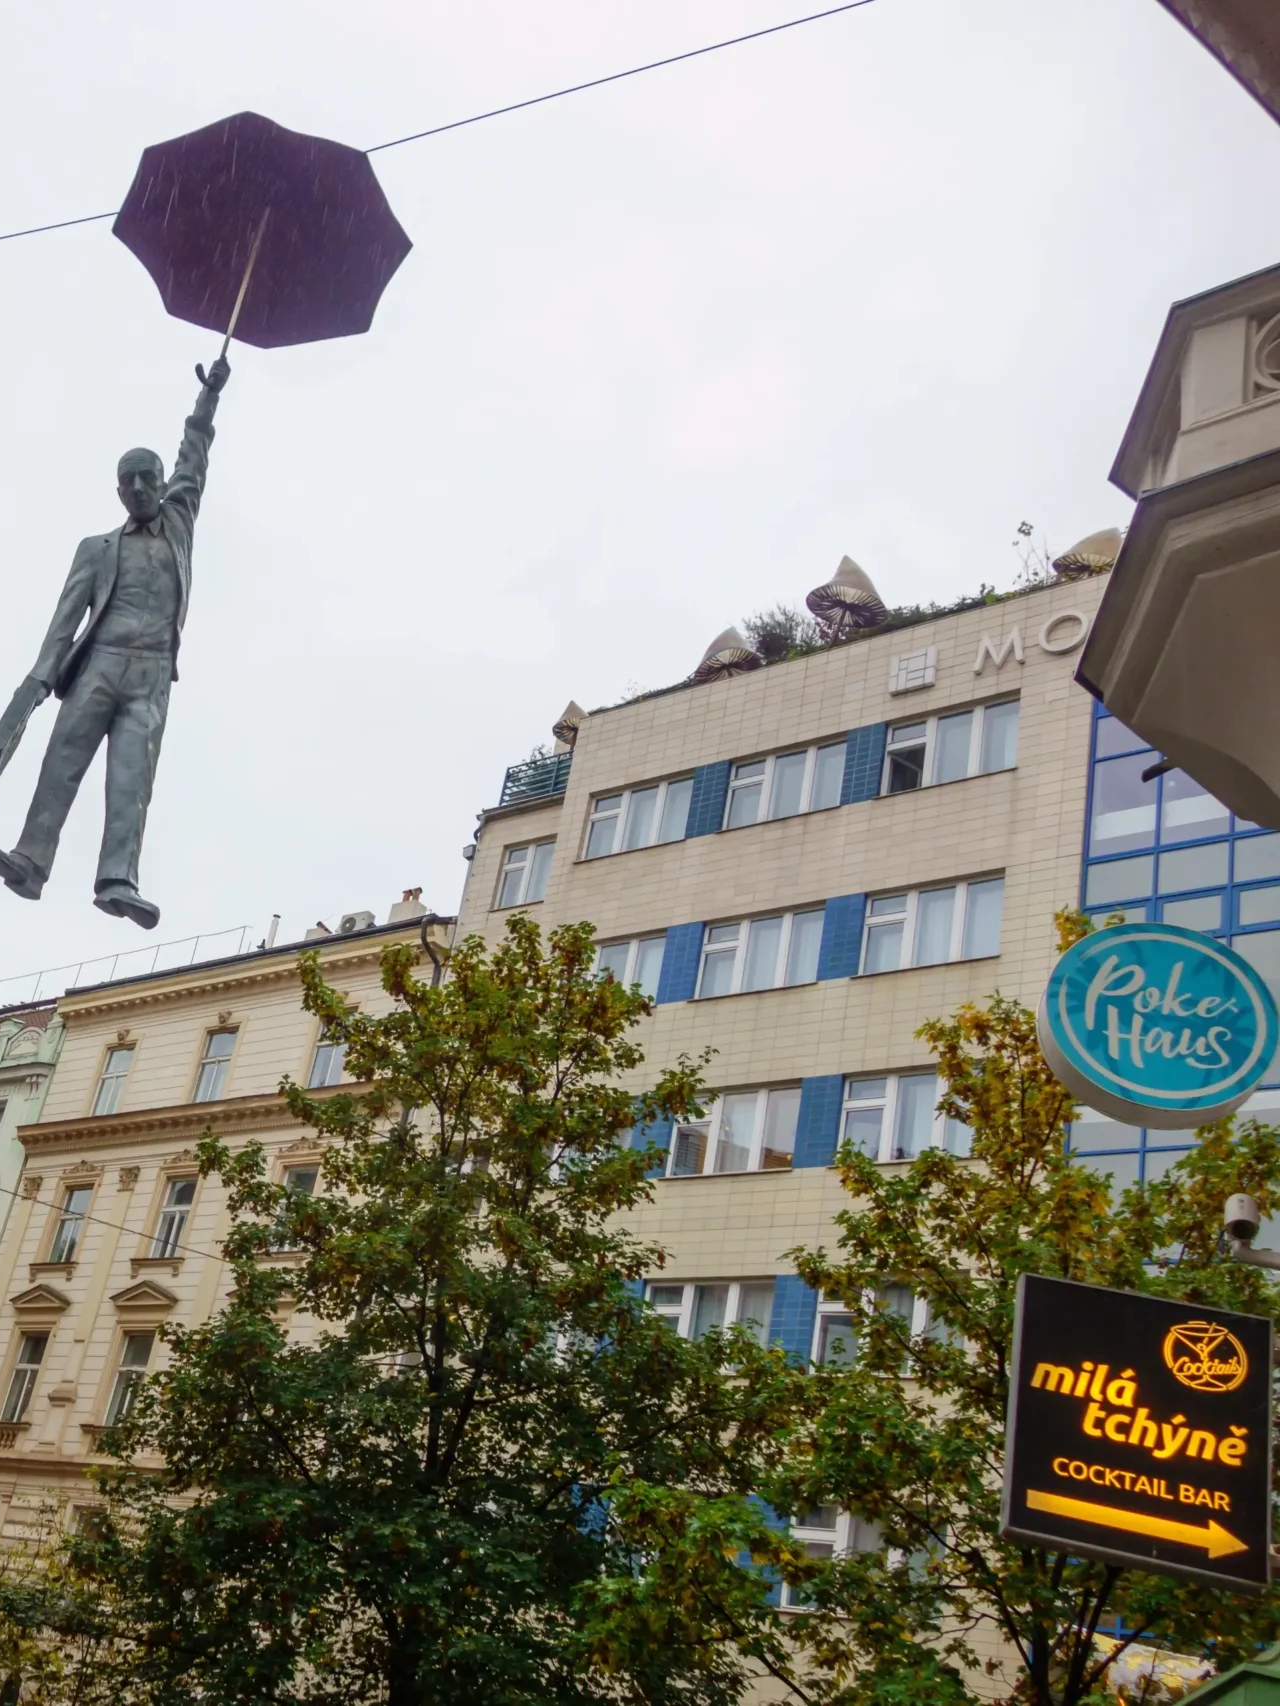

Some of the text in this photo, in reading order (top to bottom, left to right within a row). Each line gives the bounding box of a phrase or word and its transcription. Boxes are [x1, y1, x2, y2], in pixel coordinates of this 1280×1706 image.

[1084, 954, 1239, 1031] Poke
[1102, 1004, 1233, 1069] Haus
[1029, 1360, 1137, 1408] milá
[1081, 1402, 1249, 1467] tchýně
[1052, 1456, 1232, 1512] COCKTAIL BAR
